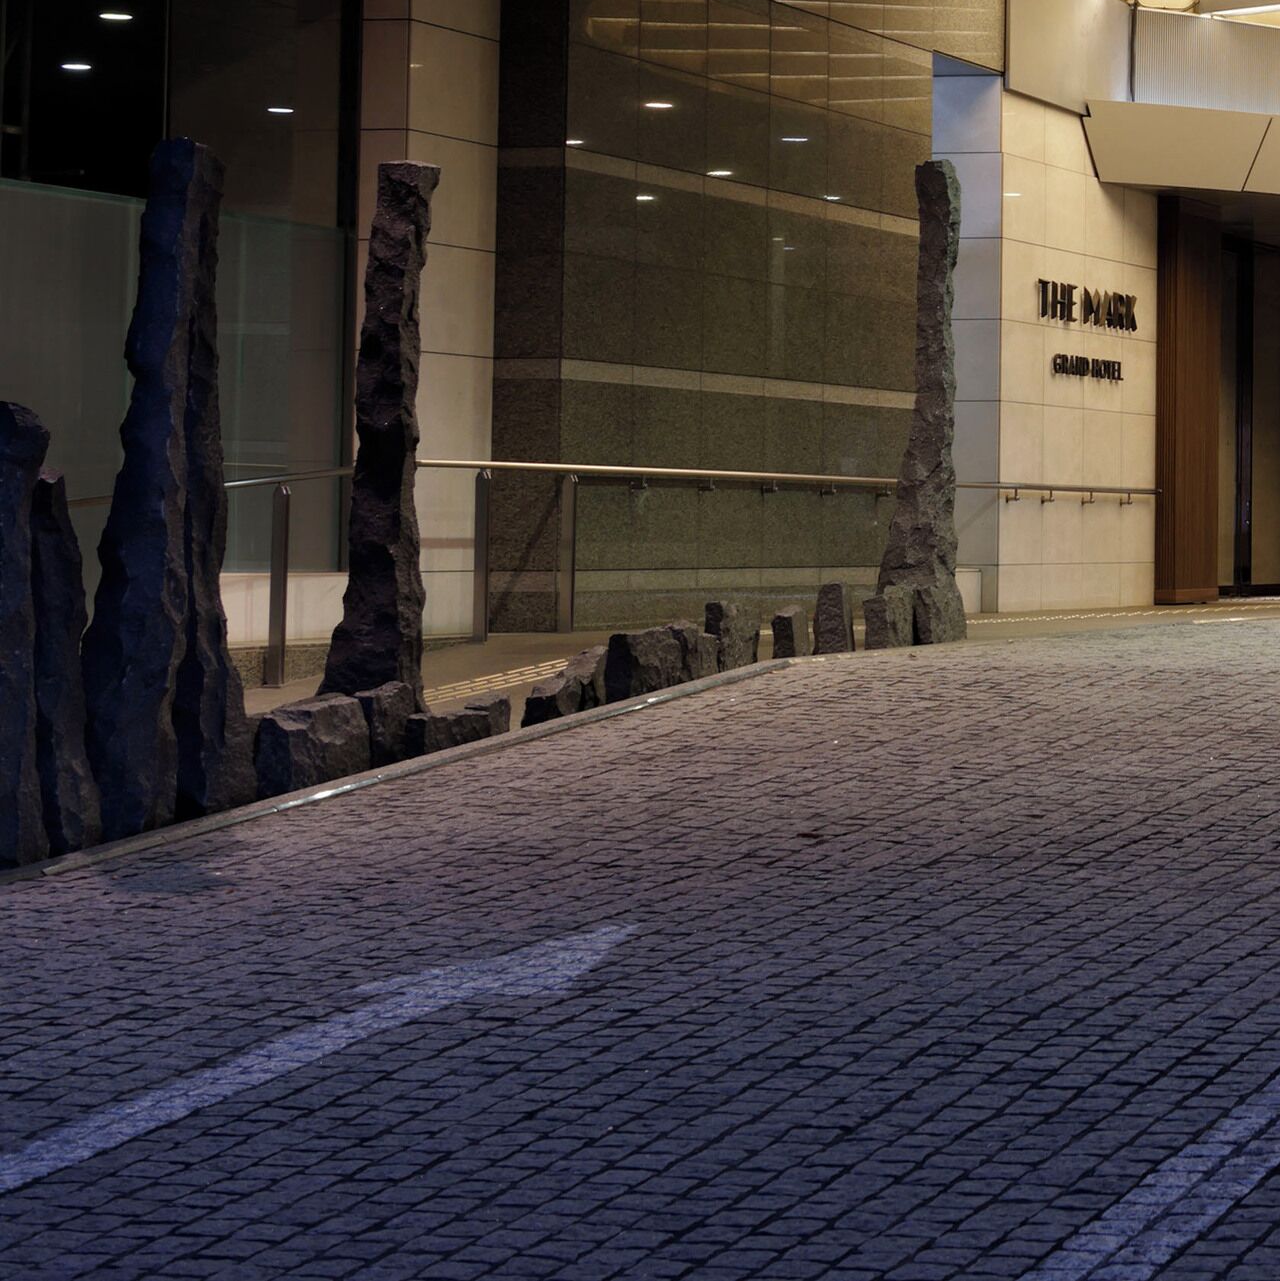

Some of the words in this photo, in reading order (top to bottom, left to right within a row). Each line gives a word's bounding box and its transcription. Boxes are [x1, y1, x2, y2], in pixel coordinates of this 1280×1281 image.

[1038, 278, 1078, 322] THE
[1083, 286, 1138, 332] MARK
[1053, 353, 1090, 377] GRAND
[1091, 358, 1124, 381] HOTEL
